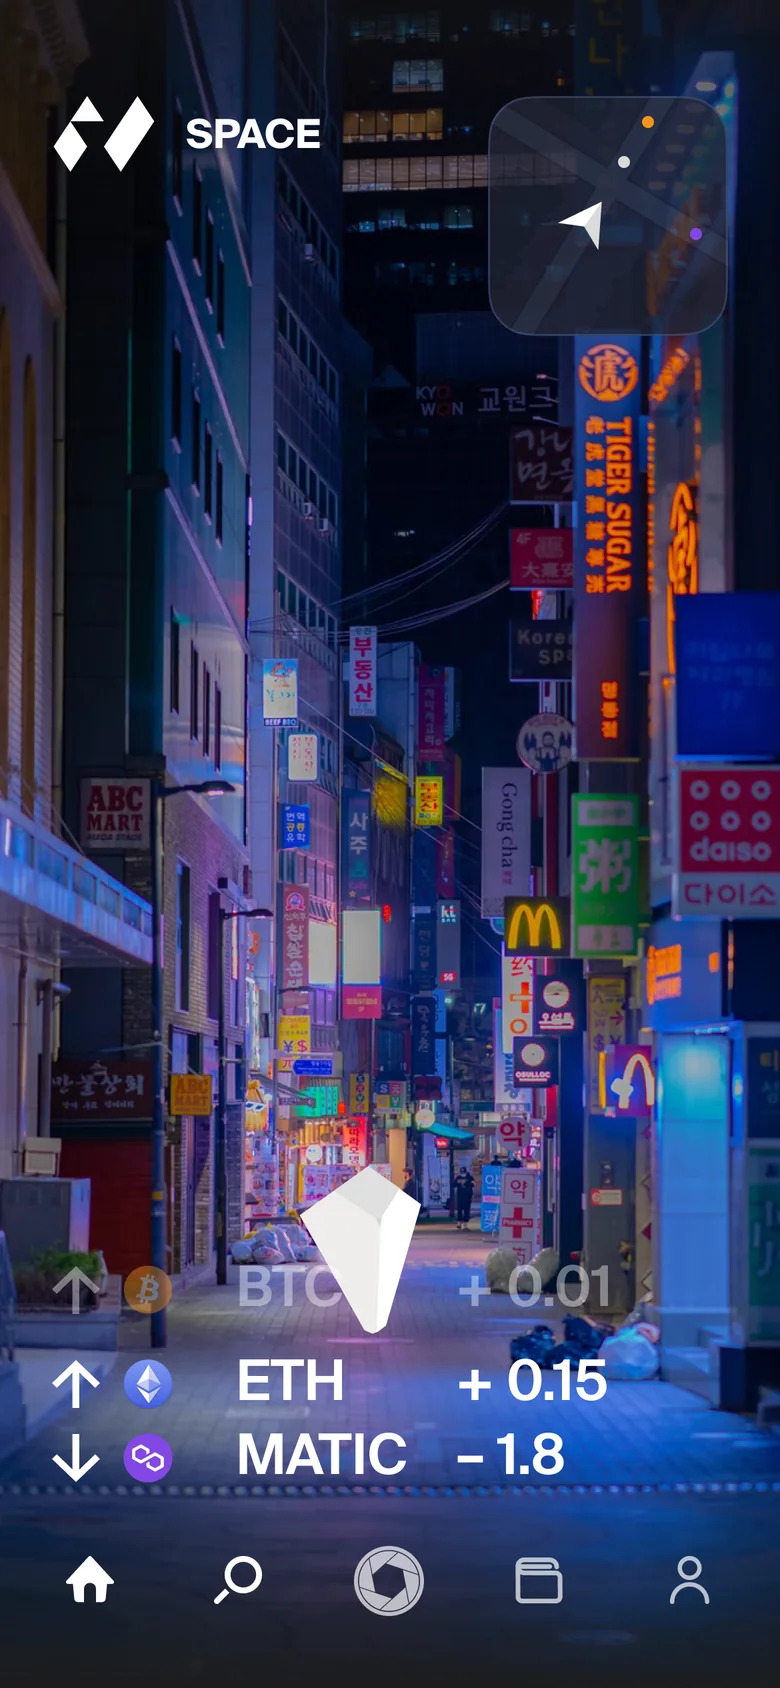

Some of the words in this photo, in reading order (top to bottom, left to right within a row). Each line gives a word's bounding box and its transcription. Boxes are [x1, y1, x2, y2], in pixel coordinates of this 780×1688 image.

[415, 384, 452, 401] KYO
[420, 401, 463, 416] WON
[605, 416, 632, 496] TIGER
[605, 501, 632, 594] SUGAR
[353, 637, 373, 703] 부동산
[87, 785, 143, 812] ABC
[419, 783, 439, 813] 부동산
[496, 783, 518, 833] Gong
[87, 814, 143, 832] MART
[287, 812, 305, 822] 번역
[287, 833, 306, 843] 유학
[350, 812, 368, 855] 사주
[502, 836, 518, 868] cha
[690, 836, 772, 862] daiso
[580, 838, 631, 894] 粥
[684, 882, 776, 906] 다이소
[297, 1040, 308, 1053] $
[176, 1078, 208, 1095] ABC
[515, 1070, 551, 1079] OSULLOC
[176, 1095, 208, 1107] MART
[499, 1121, 526, 1147] 약
[510, 1180, 527, 1200] 약
[502, 1219, 532, 1227] PHARMACY
